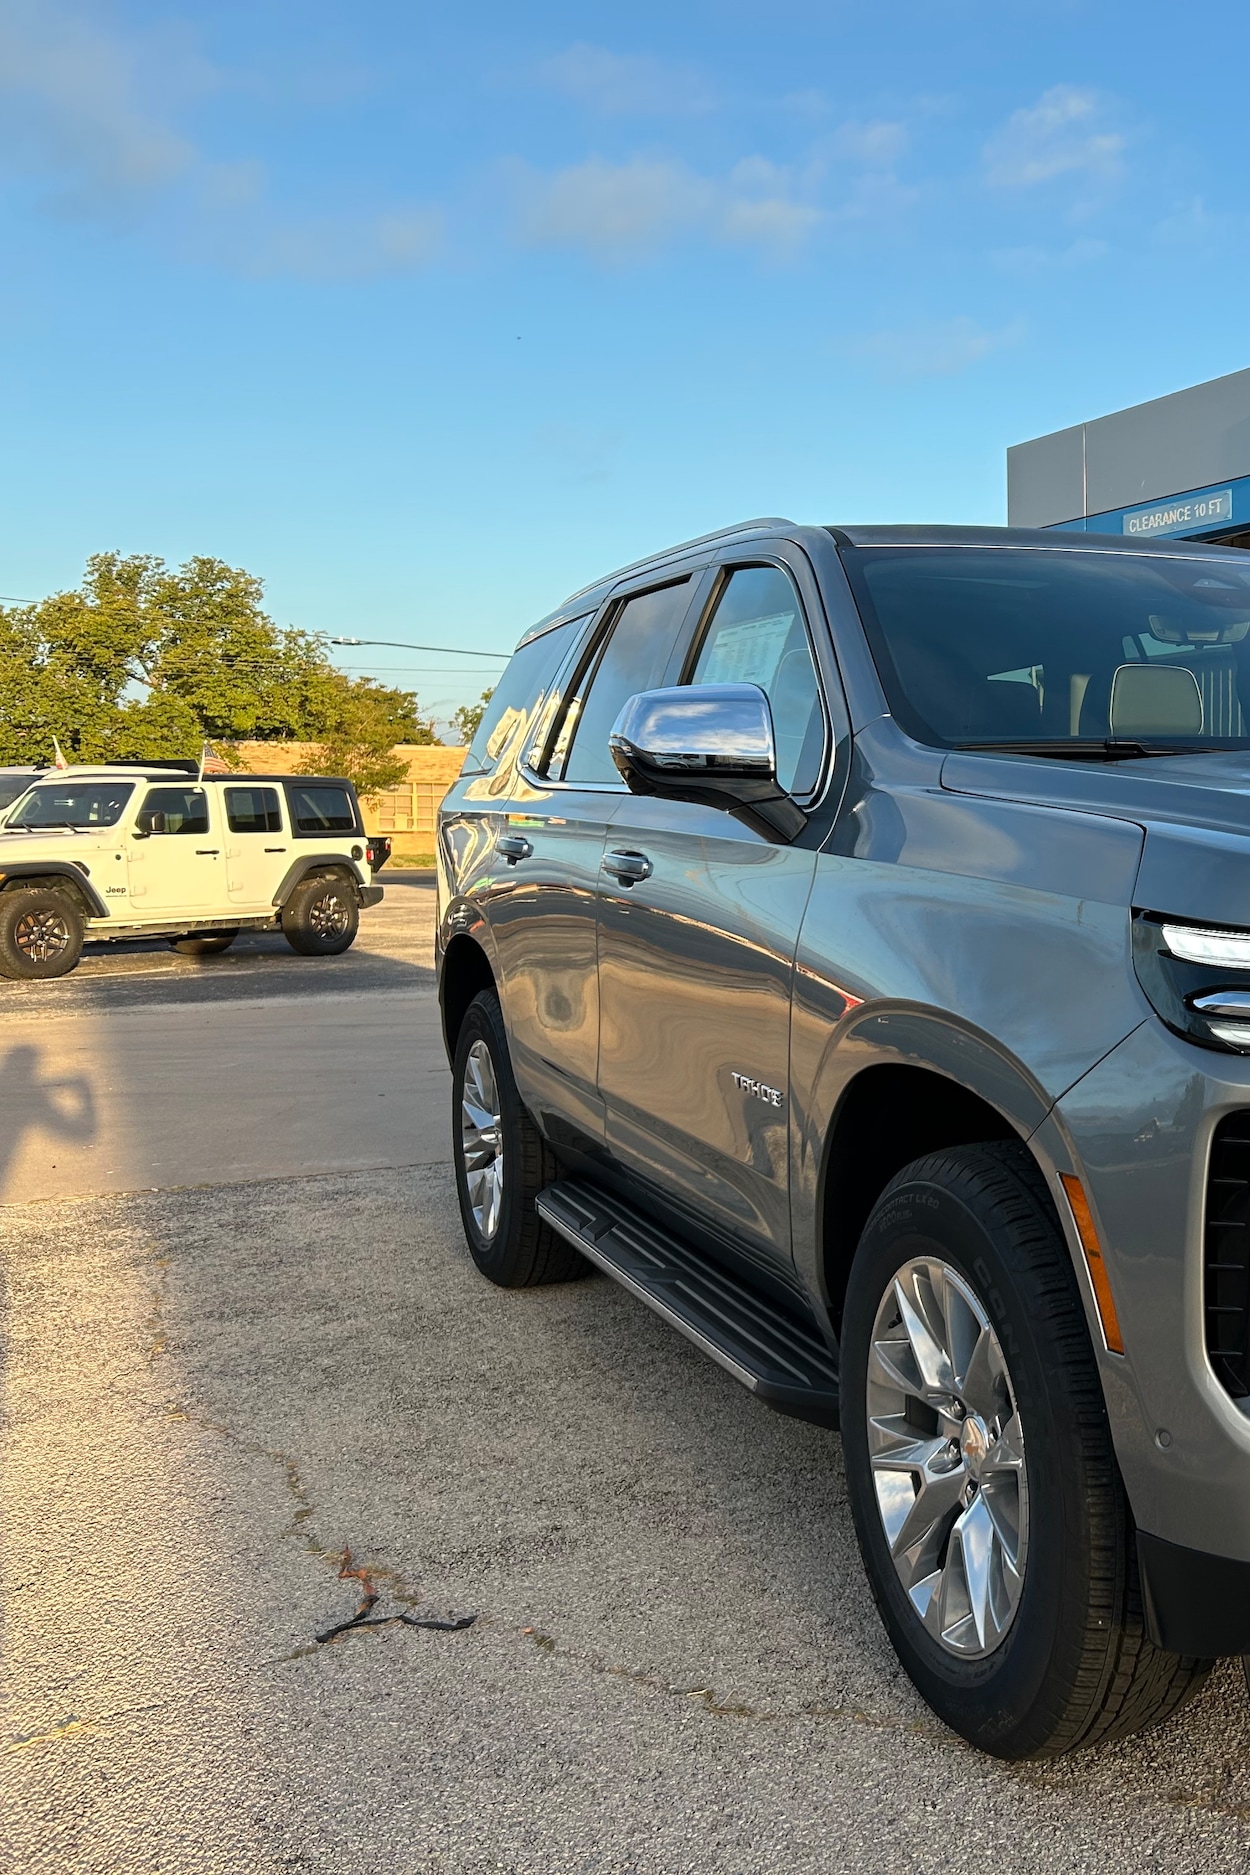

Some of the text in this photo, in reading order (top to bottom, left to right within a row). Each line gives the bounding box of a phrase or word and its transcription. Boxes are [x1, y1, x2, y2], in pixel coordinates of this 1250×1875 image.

[1129, 498, 1222, 533] CLEARANCE 10 FT
[105, 886, 127, 894] Jeep
[731, 1071, 783, 1107] TAHOE
